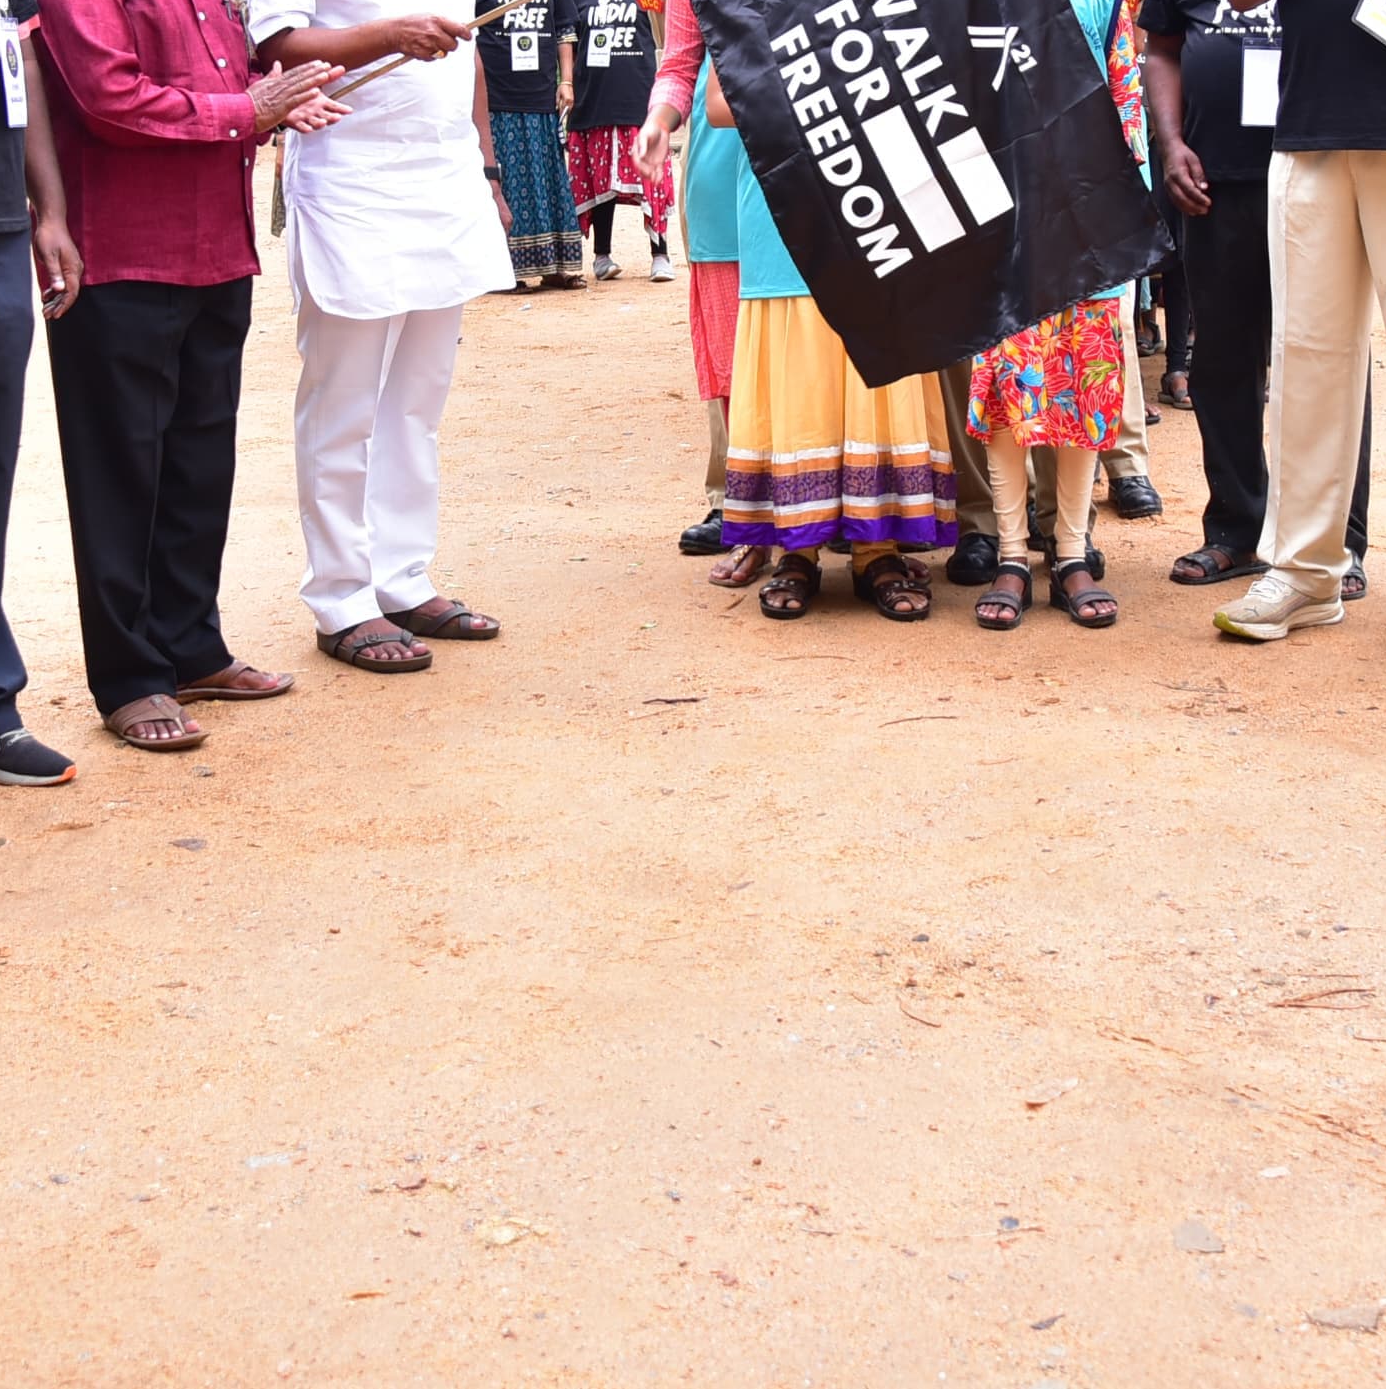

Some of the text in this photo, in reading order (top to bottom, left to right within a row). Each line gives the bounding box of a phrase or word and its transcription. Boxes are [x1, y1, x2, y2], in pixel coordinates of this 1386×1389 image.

[503, 8, 548, 29] FREE
[1010, 43, 1038, 73] 21
[769, 23, 913, 279] FREEDOM
